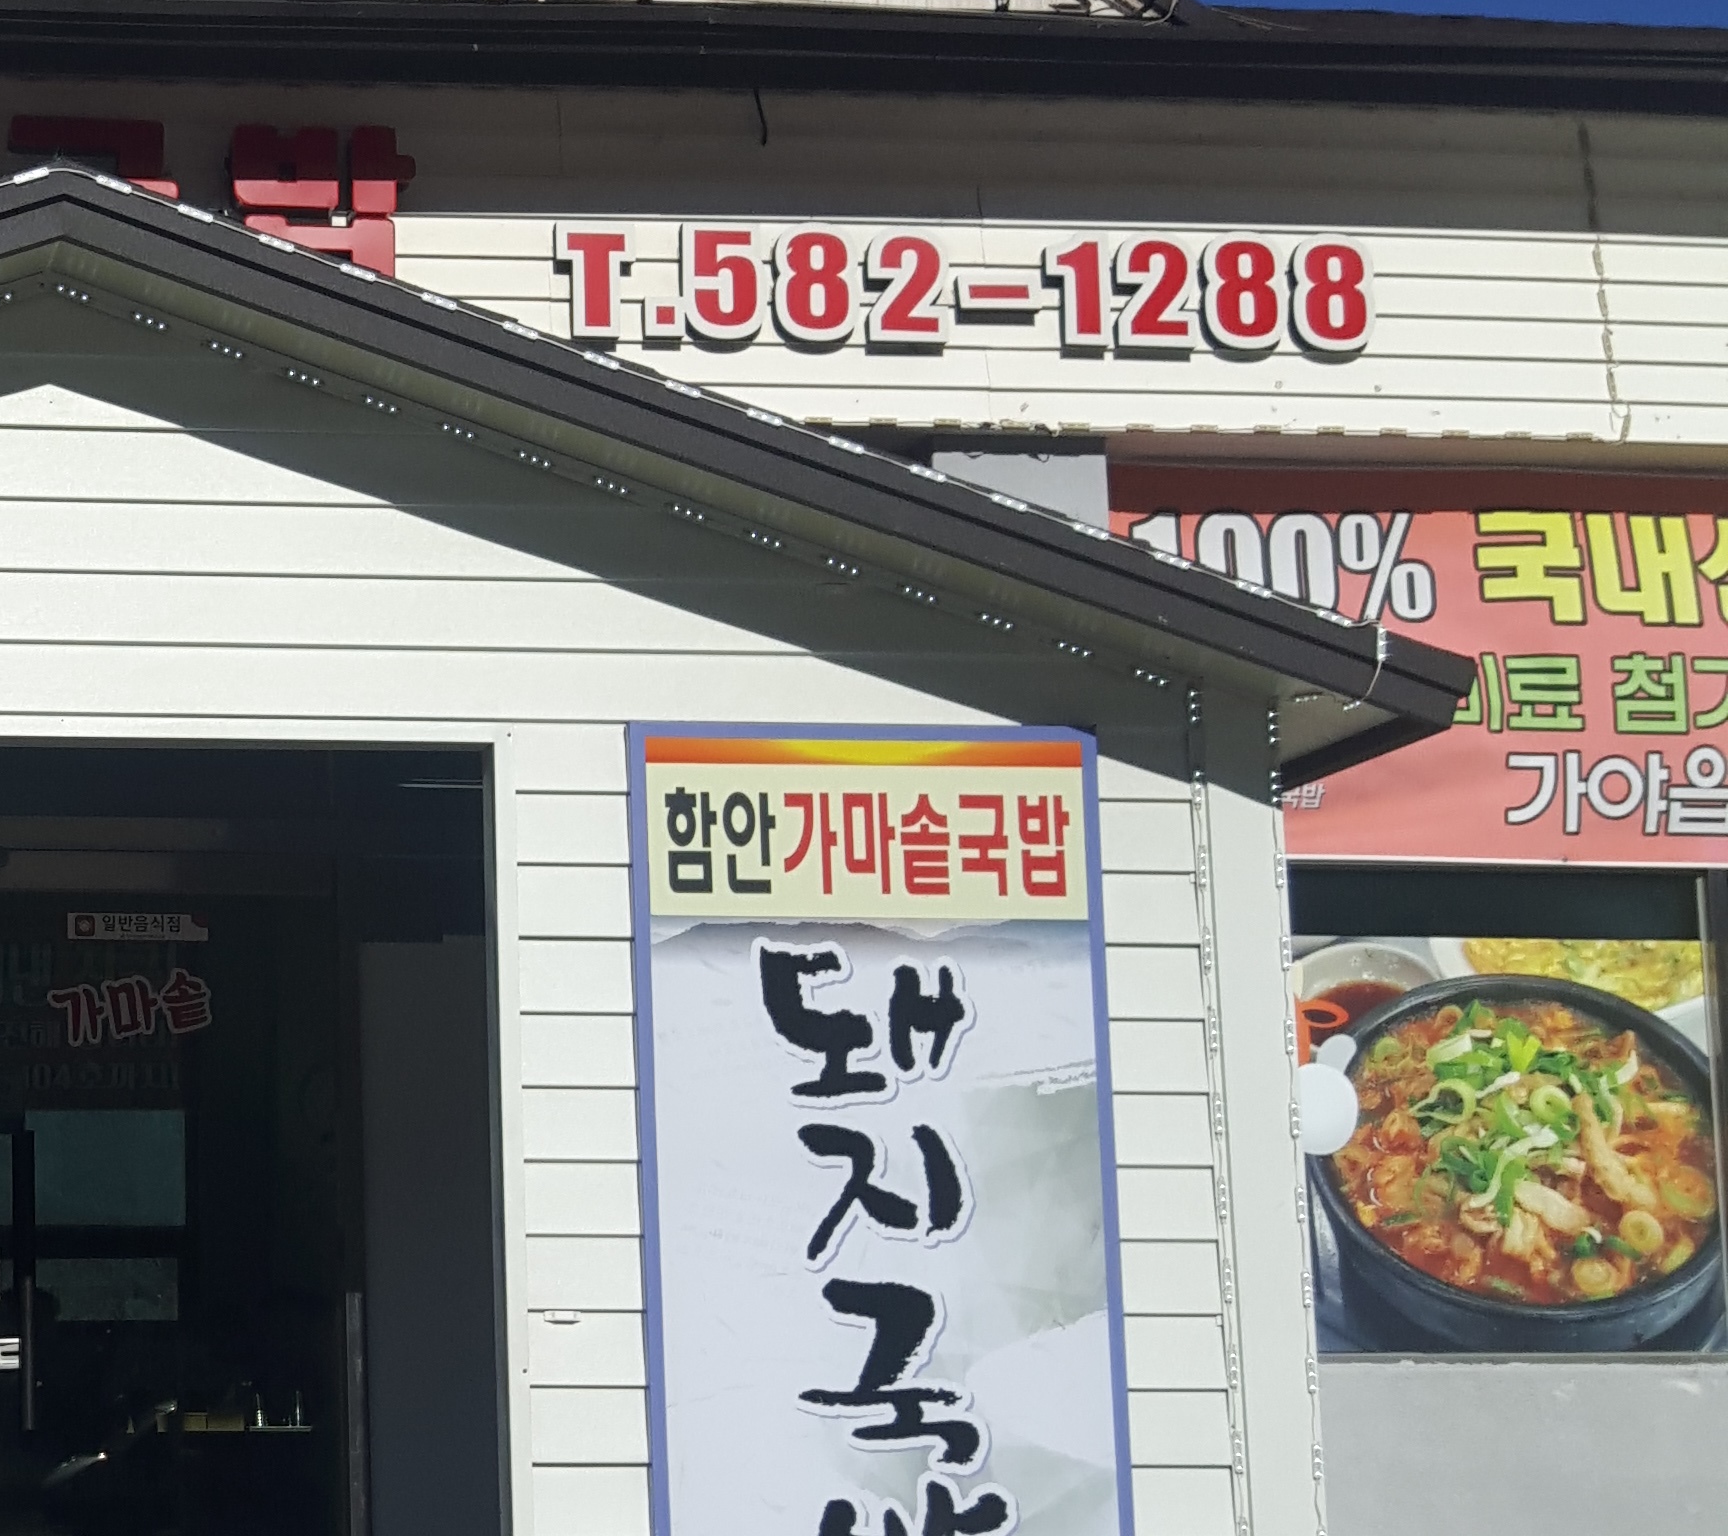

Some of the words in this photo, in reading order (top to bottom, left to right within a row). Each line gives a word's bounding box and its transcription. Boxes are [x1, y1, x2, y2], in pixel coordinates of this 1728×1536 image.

[1475, 510, 1728, 626] 국내
[101, 914, 181, 933] 일반음식점
[49, 969, 212, 1046] 가마솥
